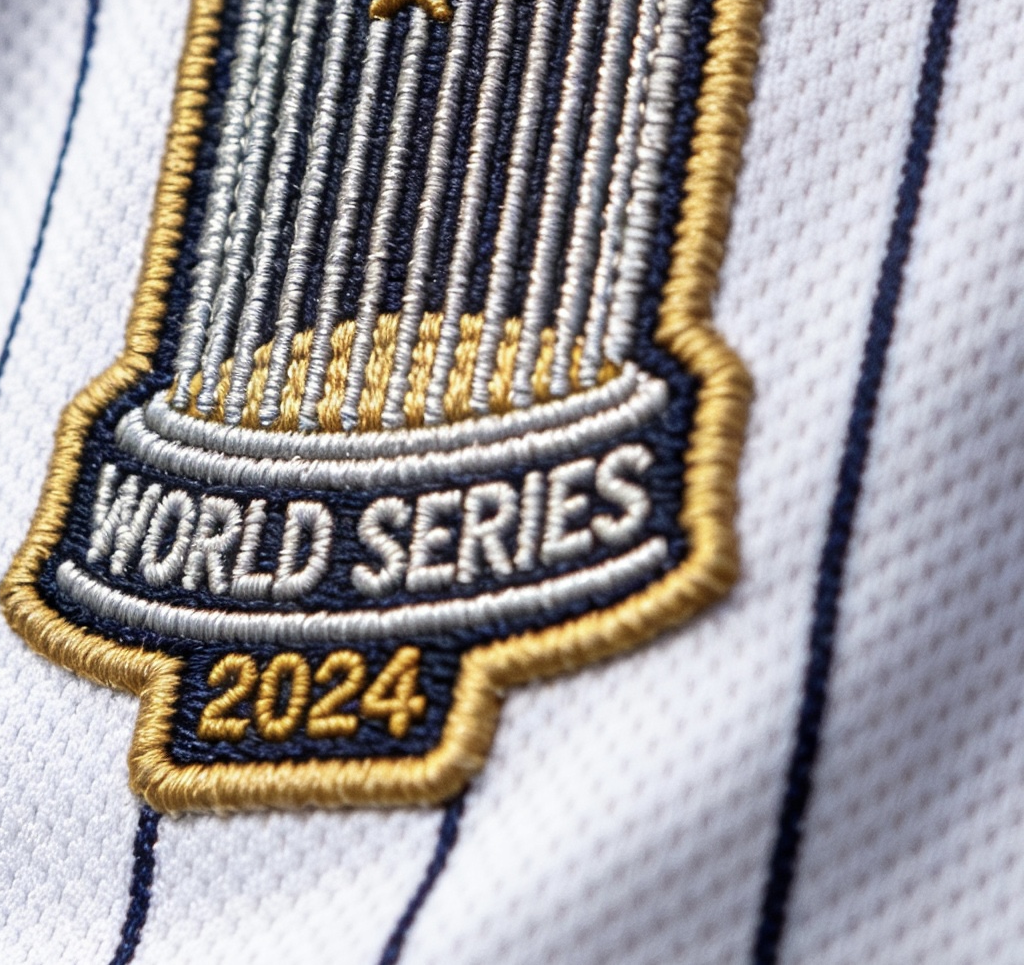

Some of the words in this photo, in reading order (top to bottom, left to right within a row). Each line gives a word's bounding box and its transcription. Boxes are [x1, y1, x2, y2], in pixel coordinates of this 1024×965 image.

[88, 463, 333, 599] WORLD
[352, 443, 655, 595] SERIES
[198, 645, 426, 739] 2024
